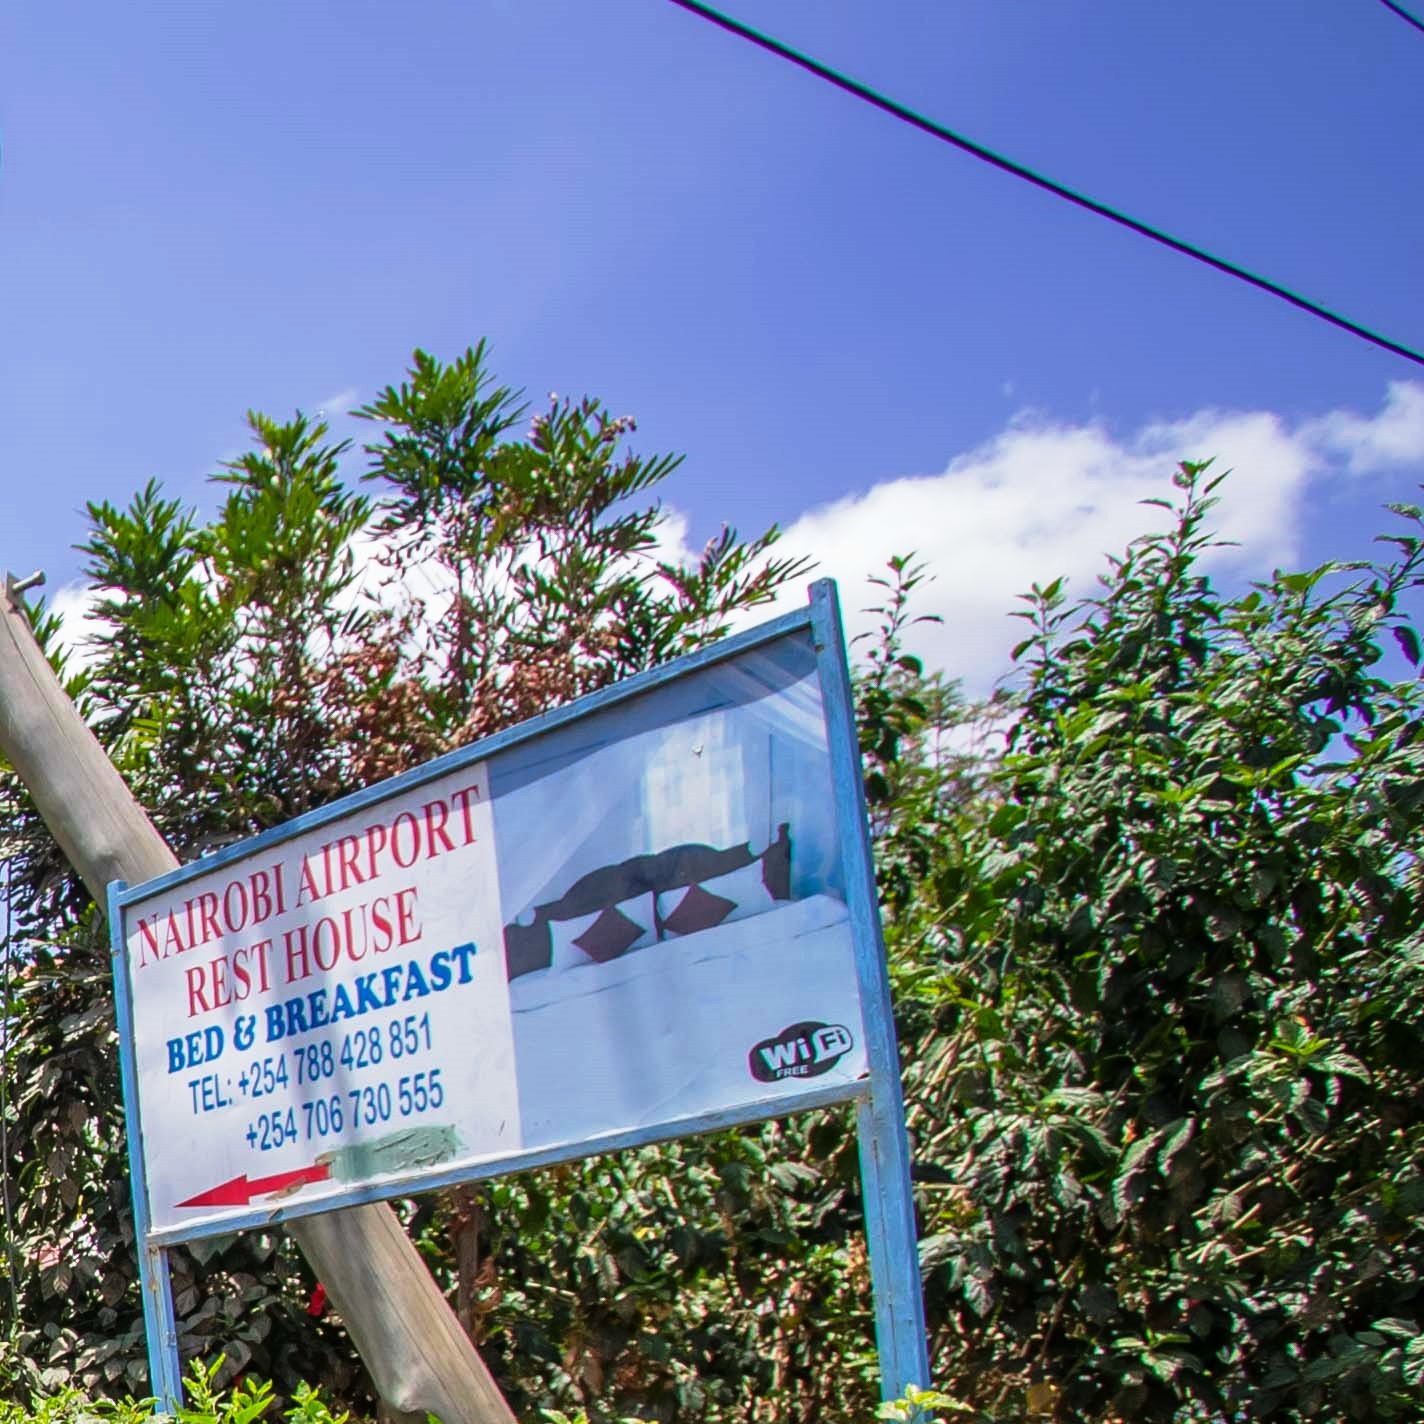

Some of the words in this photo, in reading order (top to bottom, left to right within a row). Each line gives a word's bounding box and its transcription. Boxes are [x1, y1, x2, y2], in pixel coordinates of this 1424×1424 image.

[137, 862, 287, 968] NAIROBI
[295, 785, 479, 908] AIRPORT
[166, 1025, 225, 1074] BED
[233, 1014, 257, 1051] &
[265, 942, 478, 1043] BREAKFAST
[185, 939, 273, 1018] REST
[282, 887, 423, 984] HOUSE
[188, 1073, 232, 1115] TEL:
[238, 1053, 288, 1098] +254
[294, 1040, 334, 1085] 788
[341, 1026, 382, 1071] 428
[389, 1011, 432, 1059] 851
[246, 1106, 297, 1151] +254
[303, 1096, 344, 1139] 706
[349, 1082, 392, 1128] 730
[399, 1069, 444, 1116] 555
[776, 1065, 808, 1077] FREE
